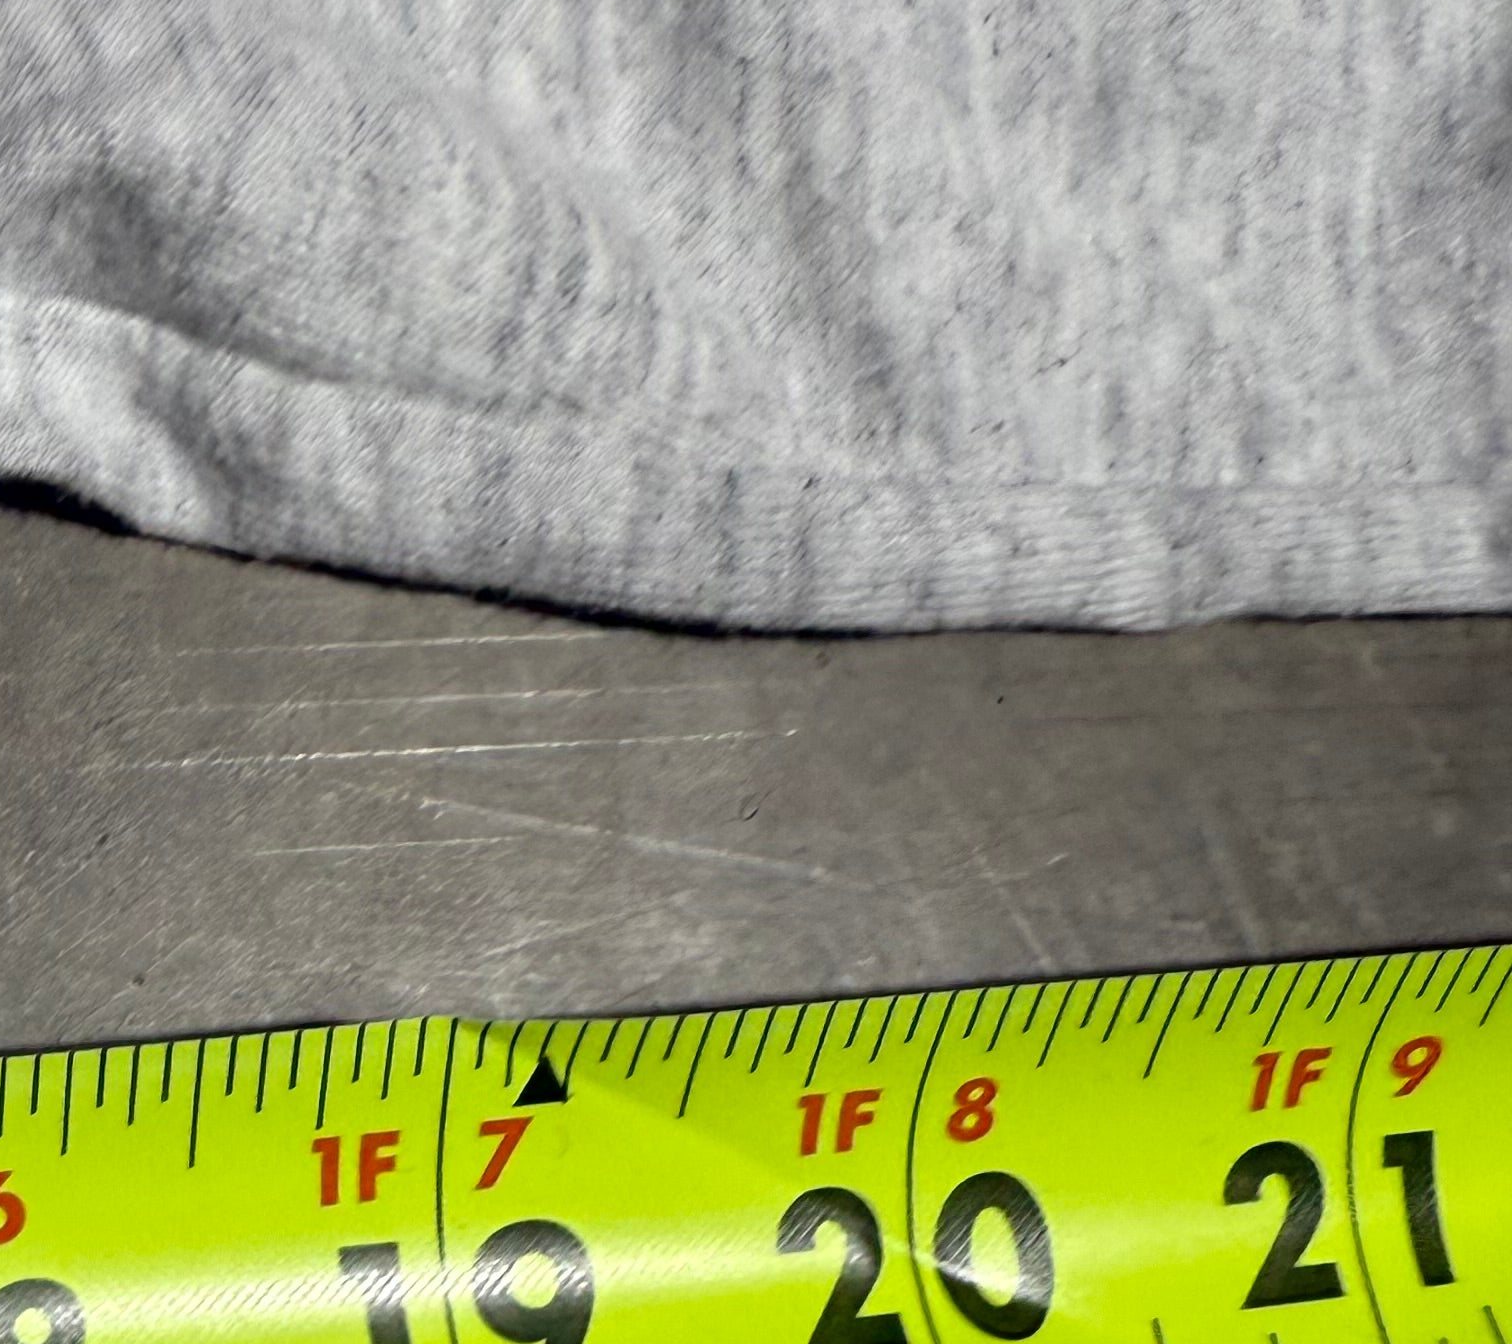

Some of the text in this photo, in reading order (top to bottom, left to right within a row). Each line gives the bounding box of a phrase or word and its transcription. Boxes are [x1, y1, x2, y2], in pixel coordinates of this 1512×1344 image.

[1249, 1035, 1444, 1112] 1F 9
[797, 1077, 998, 1156] 1F 8
[311, 1115, 534, 1207] 1F 7
[1222, 1129, 1456, 1310] 21
